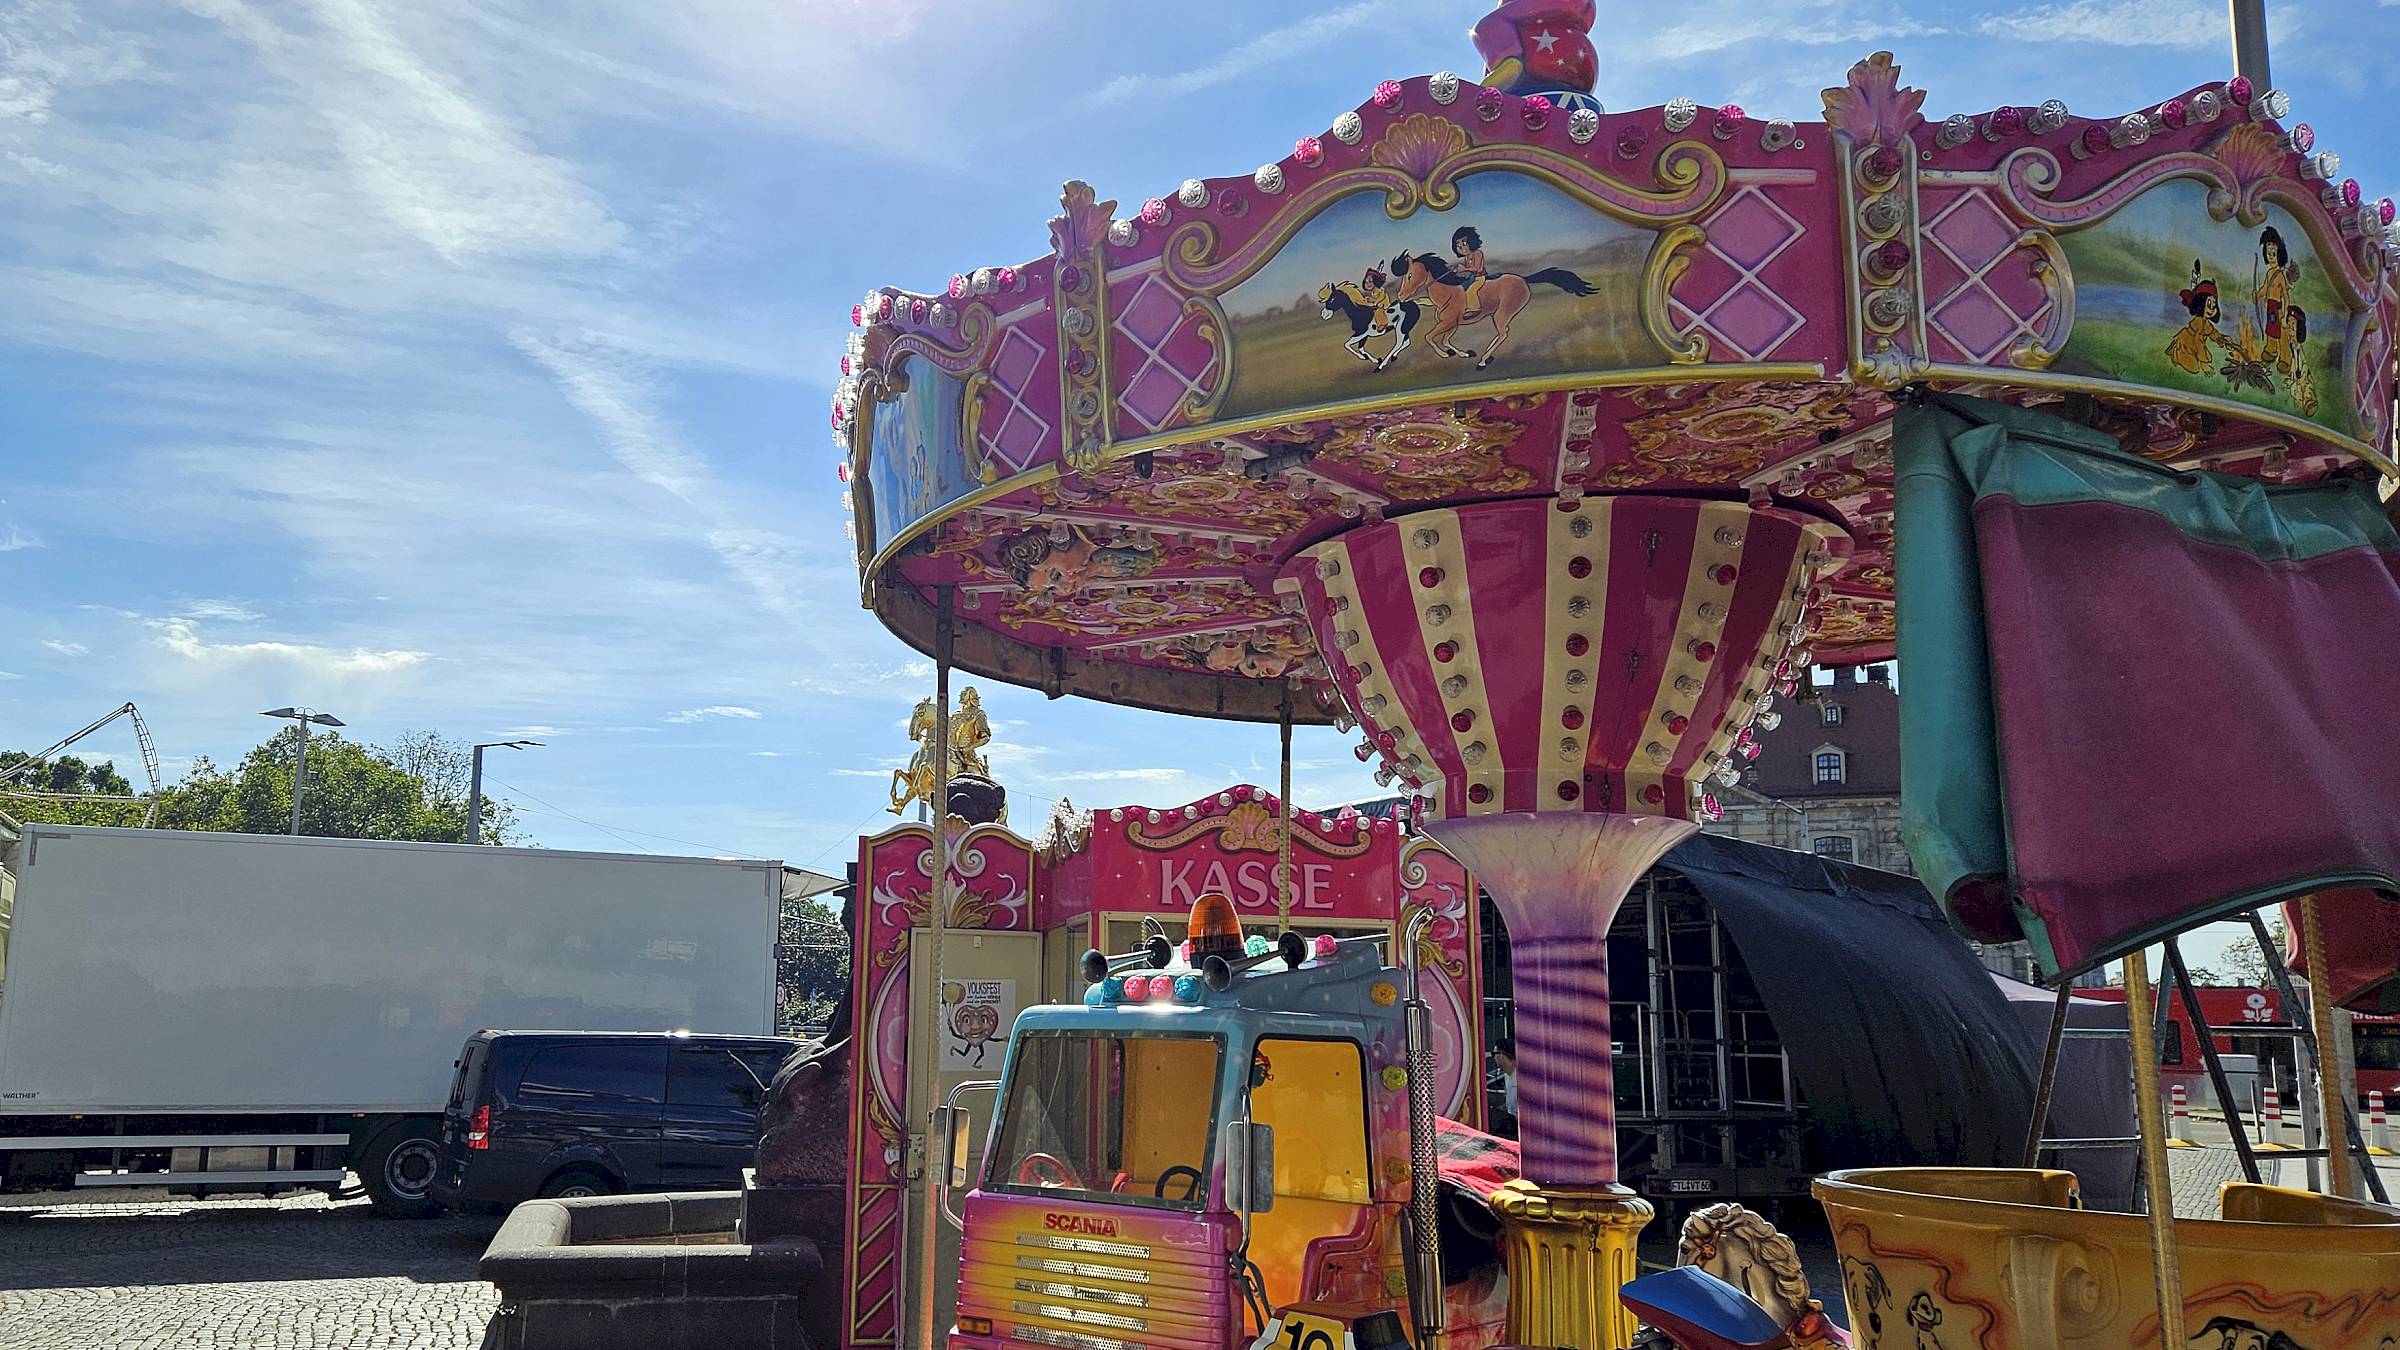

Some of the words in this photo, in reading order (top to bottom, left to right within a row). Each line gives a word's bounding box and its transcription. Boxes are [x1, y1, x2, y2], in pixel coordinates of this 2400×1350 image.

[1160, 859, 1335, 910] KASSE
[967, 982, 1002, 995] VOLKSFEST
[1045, 1213, 1117, 1237] SCANIA
